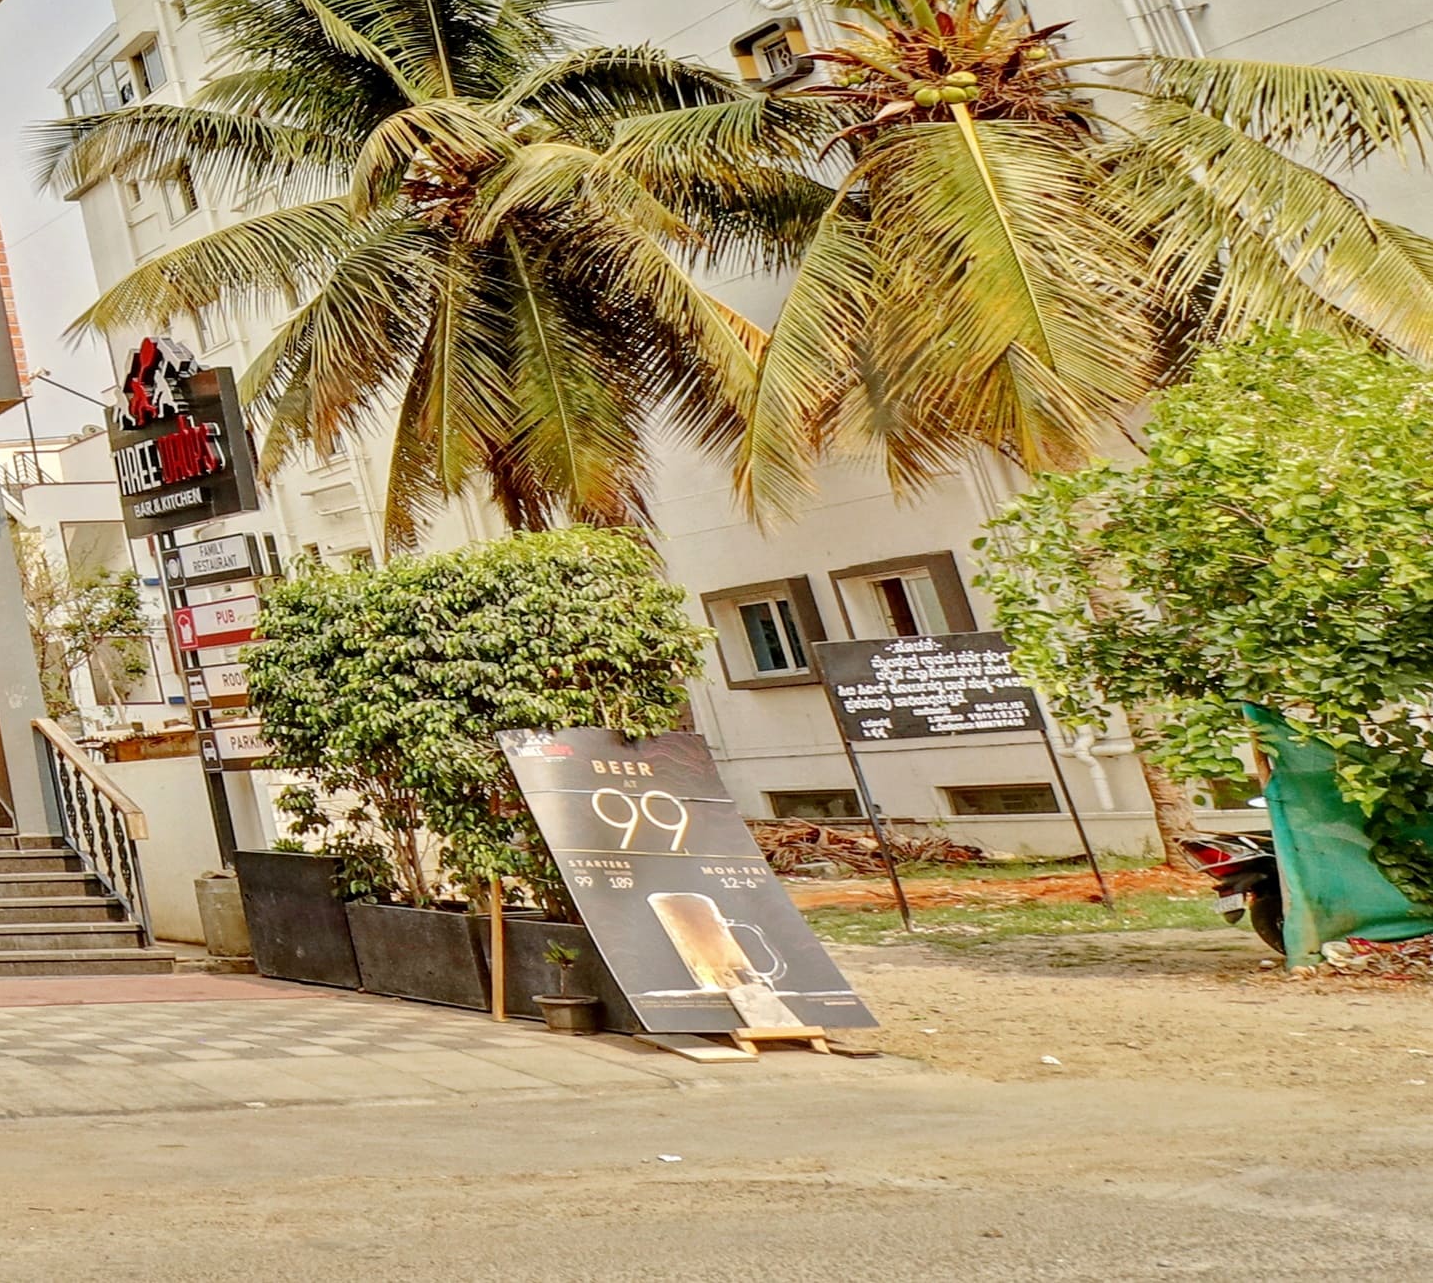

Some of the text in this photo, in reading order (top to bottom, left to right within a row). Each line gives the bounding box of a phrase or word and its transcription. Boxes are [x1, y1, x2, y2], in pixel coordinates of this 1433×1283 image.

[111, 439, 162, 496] HREE
[134, 501, 156, 518] BAR
[161, 486, 204, 511] KITCHEN
[198, 541, 225, 557] FAMILY
[192, 554, 239, 573] RESTAURANT
[215, 609, 236, 625] PUB
[591, 760, 654, 777] BEER
[591, 788, 689, 851] 99
[567, 860, 631, 869] STARTERS
[700, 866, 767, 876] MON-FRI
[574, 876, 594, 887] 99
